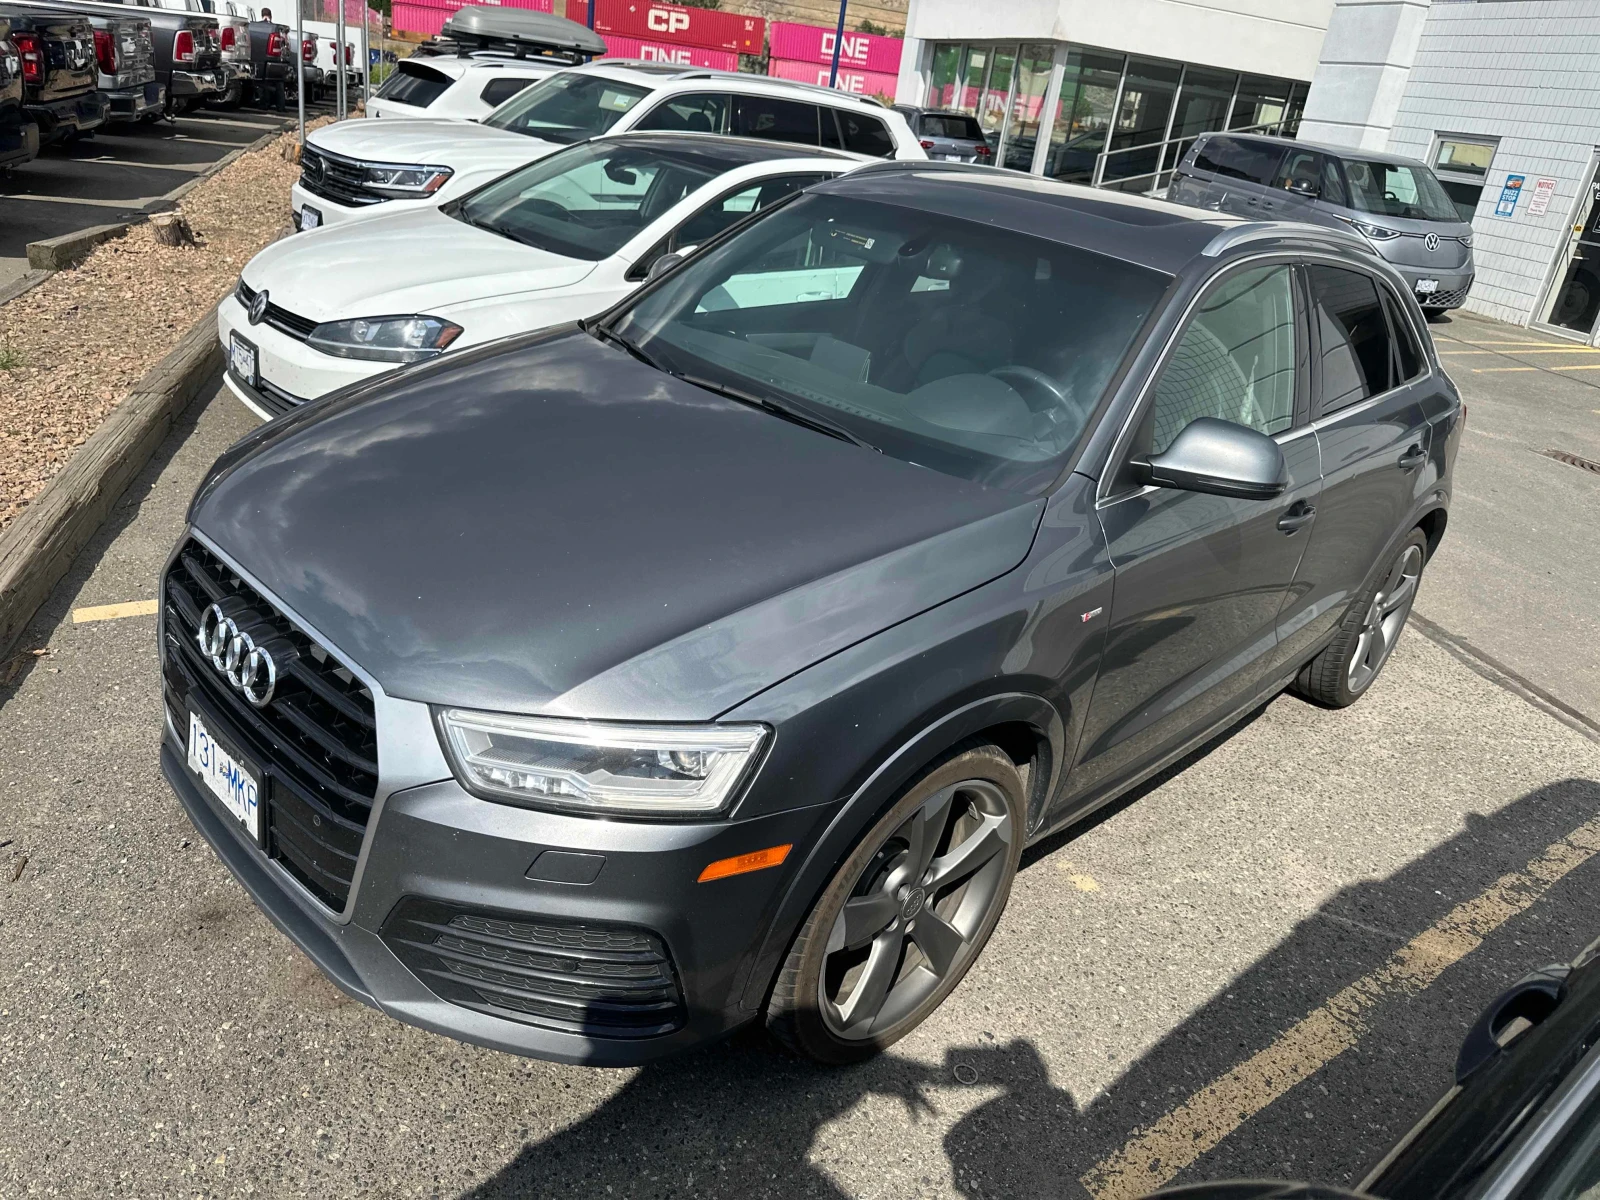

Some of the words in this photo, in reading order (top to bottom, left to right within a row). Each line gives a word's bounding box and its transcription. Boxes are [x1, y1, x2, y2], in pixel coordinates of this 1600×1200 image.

[647, 8, 690, 33] CP
[640, 45, 692, 66] ONE
[820, 32, 870, 59] ONE
[816, 70, 865, 94] ONE
[1503, 189, 1519, 197] BUZZ
[1537, 181, 1555, 190] NOTICE
[1501, 194, 1517, 202] STOP
[193, 723, 215, 776] 131
[227, 759, 258, 816] MKP
